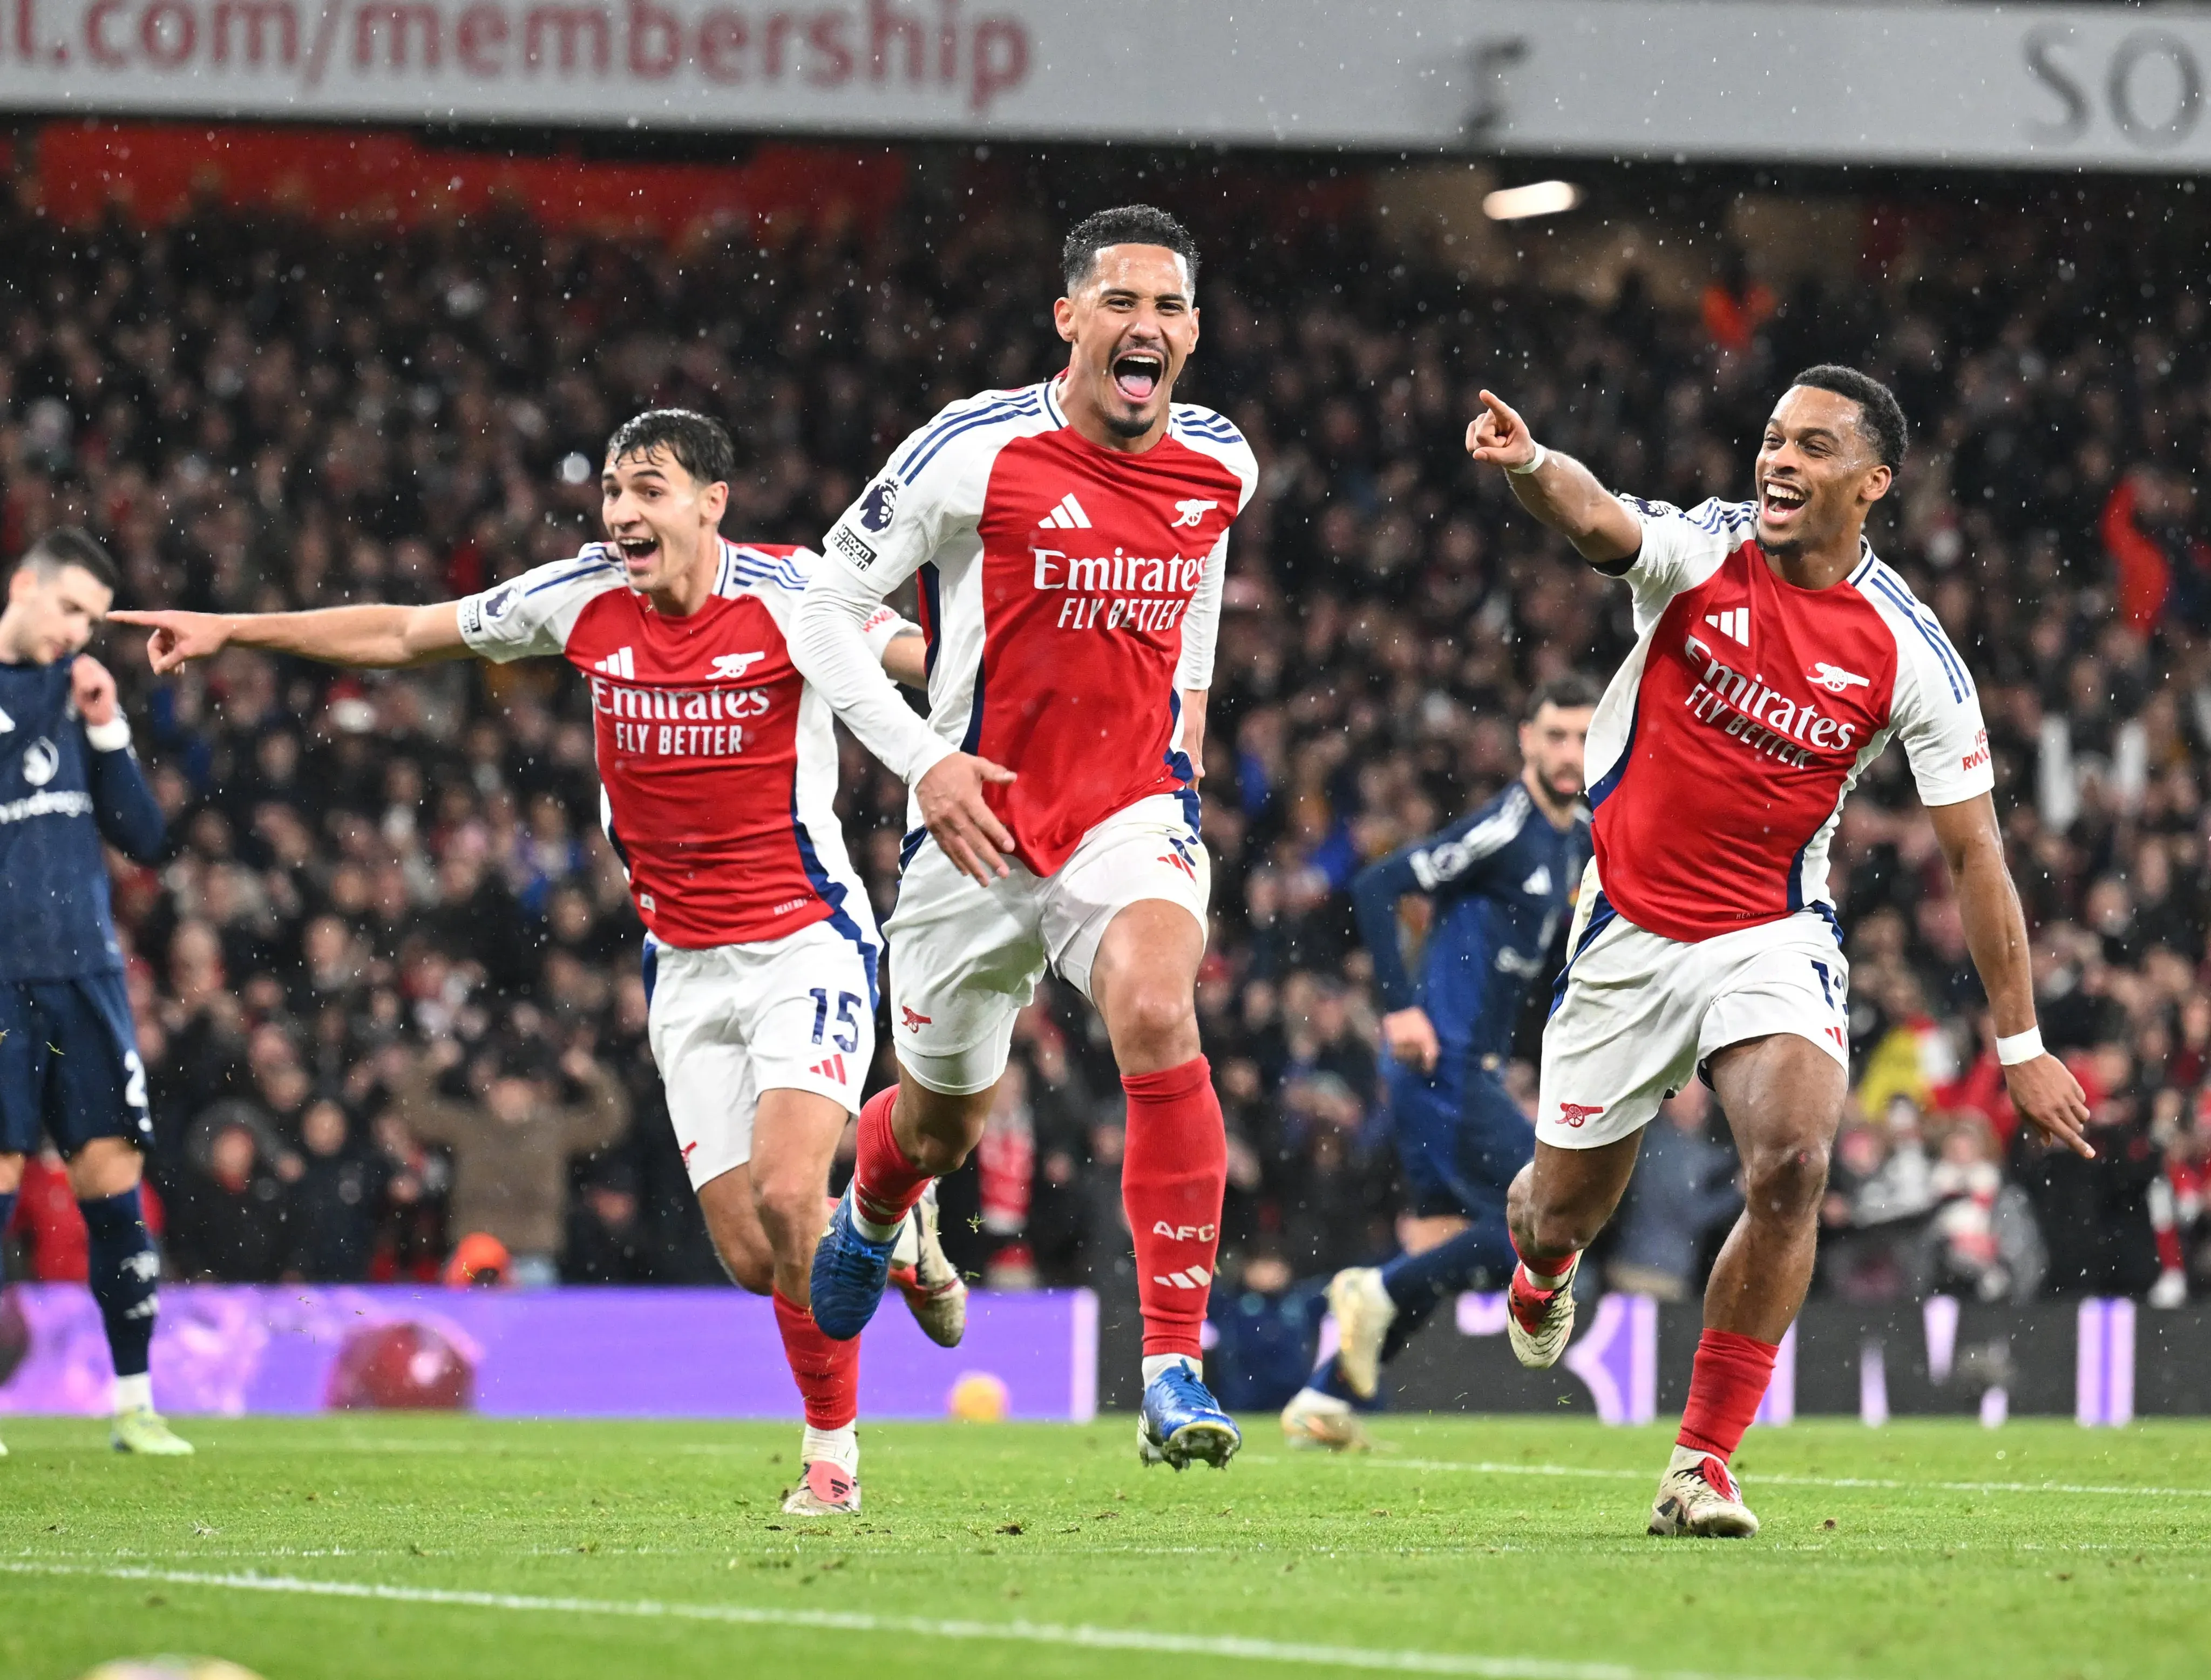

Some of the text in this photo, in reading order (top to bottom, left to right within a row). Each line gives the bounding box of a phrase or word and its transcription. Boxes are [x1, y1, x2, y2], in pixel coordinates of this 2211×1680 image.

[2020, 23, 2203, 149] SO
[839, 541, 870, 572] racism
[845, 534, 872, 561] room
[1033, 547, 1207, 593] Emirates
[1057, 597, 1185, 632] FLY BETTER
[591, 677, 770, 720] Emirates
[1684, 634, 1856, 751] Emirates
[615, 722, 743, 756] FLY BETTER
[1685, 682, 1814, 770] FLY BETTER
[1974, 727, 1987, 747] VIS
[810, 988, 862, 1053] 15
[1152, 1220, 1215, 1243] AFC
